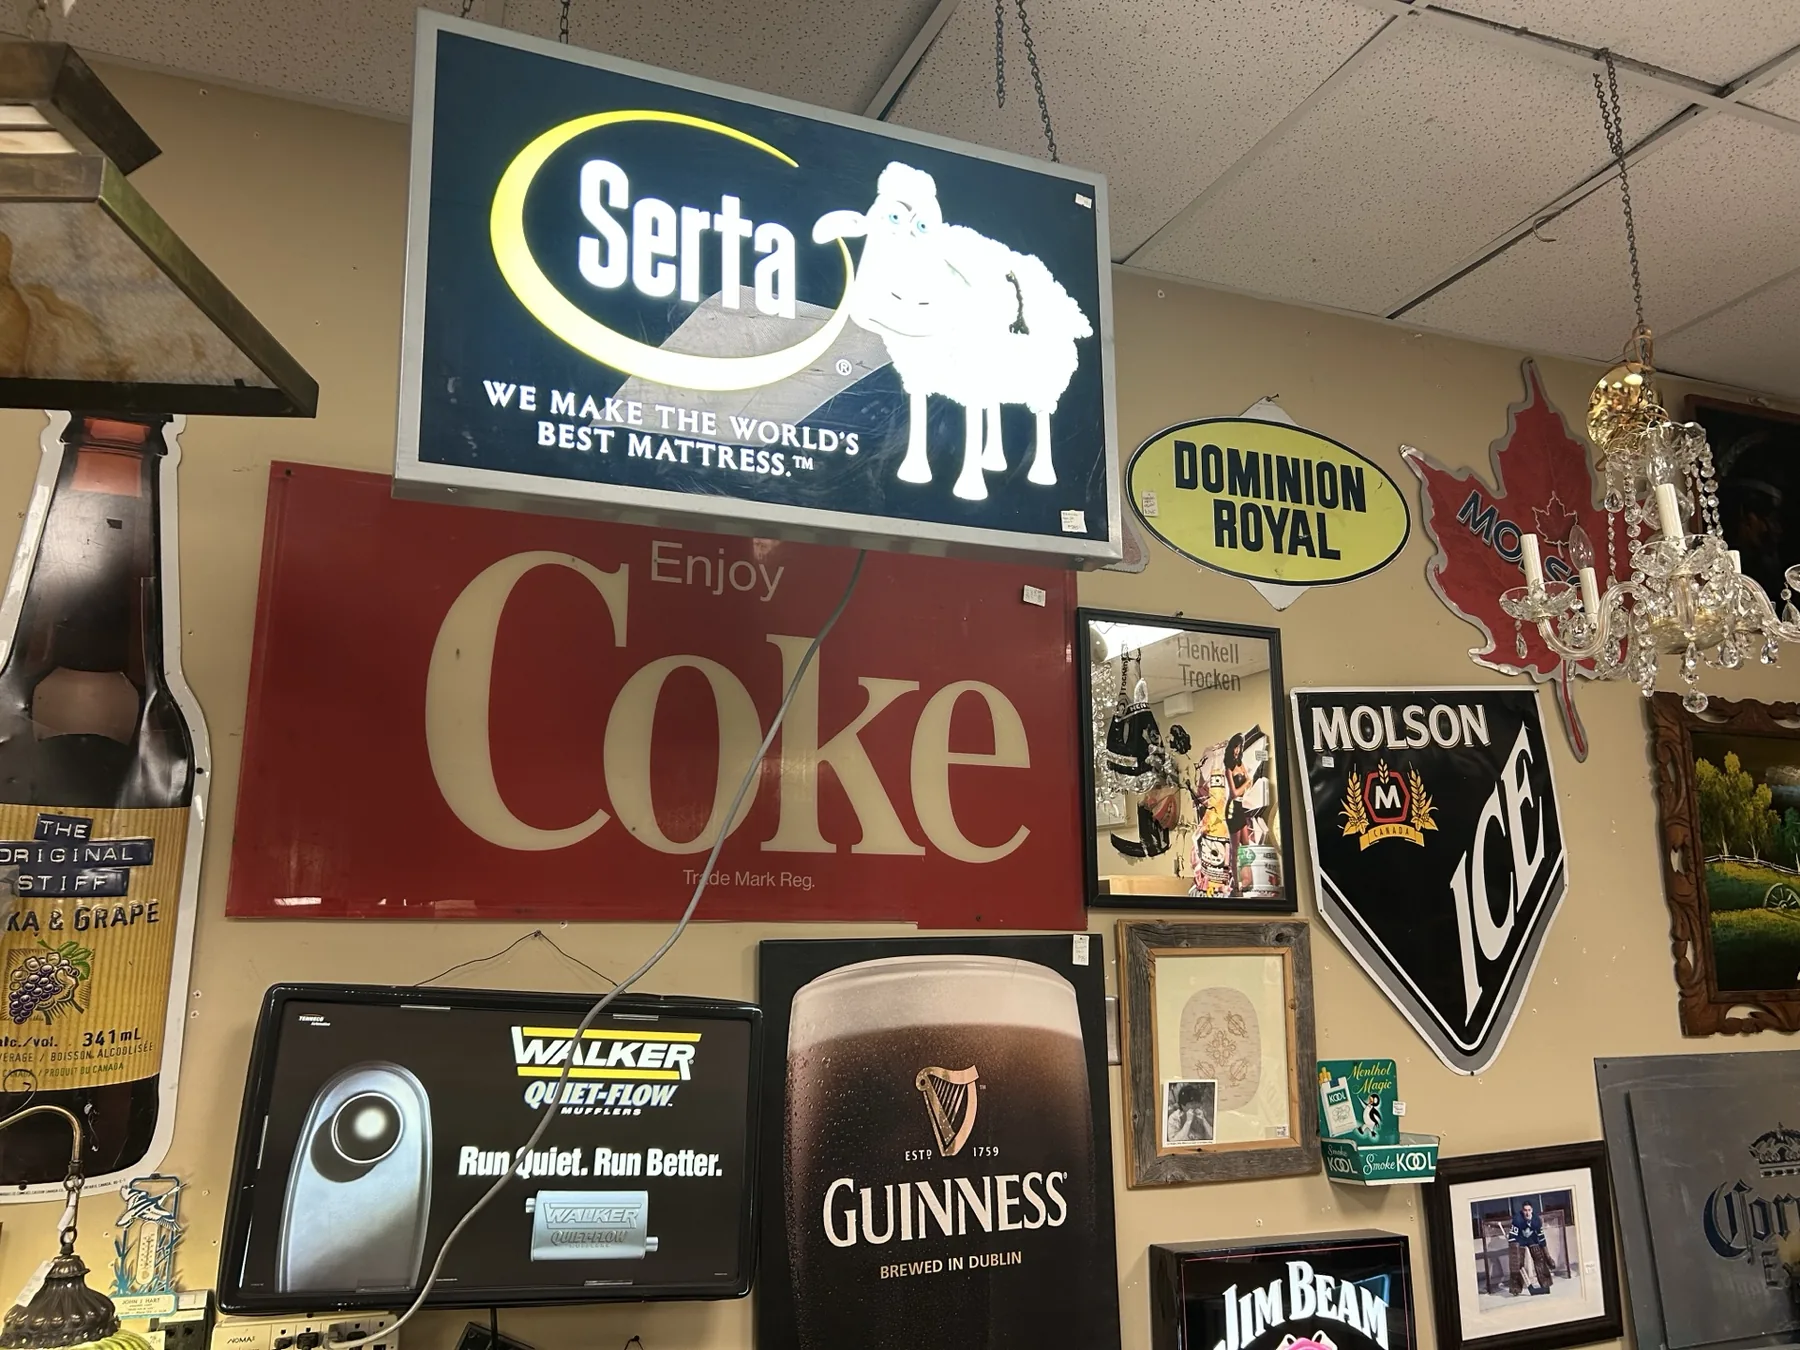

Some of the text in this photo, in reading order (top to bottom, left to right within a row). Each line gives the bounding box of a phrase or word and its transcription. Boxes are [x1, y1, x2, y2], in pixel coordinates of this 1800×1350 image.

[579, 159, 796, 319] Serta
[482, 380, 860, 456] WE MAKE THE WORLD'S
[537, 421, 615, 454] BEST
[1173, 439, 1367, 513] DOMINION
[1213, 498, 1341, 560] ROYAL
[651, 540, 785, 602] Enjoy
[1177, 636, 1240, 664] Henkell
[1178, 663, 1241, 692] Trocken
[425, 550, 1031, 864] Coke
[1311, 704, 1492, 752] MOLSON
[1374, 784, 1402, 809] M
[40, 819, 89, 839] THE
[1373, 826, 1410, 837] CANADA
[0, 847, 134, 863] ORIGINAL
[18, 875, 109, 891] STIFF
[735, 871, 777, 887] Mark
[780, 871, 815, 891] Reg.
[1450, 720, 1546, 1028] ICE
[49, 908, 64, 931] &
[74, 901, 160, 932] GRAPE
[82, 1029, 116, 1048] 341
[120, 1027, 142, 1042] mL
[51, 1050, 95, 1062] BOISSON
[92, 1062, 124, 1073] CANADA
[1347, 1061, 1393, 1081] Menthol
[524, 1080, 680, 1109] QUIET-FLOW
[1328, 1091, 1347, 1104] KOOL
[1352, 1077, 1393, 1094] Magic
[560, 1107, 642, 1116] MUFFLERS
[458, 1146, 722, 1179] Run Quiet. Run Better.
[973, 1146, 1000, 1157] 1759
[1327, 1144, 1348, 1157] Smoke
[1363, 1151, 1437, 1175] Smoke KOOL
[1327, 1156, 1358, 1174] KOOL
[543, 1202, 640, 1229] WALKER
[879, 1250, 1022, 1280] BREWED IN DUBLIN
[1213, 1260, 1390, 1350] JIM BEAM
